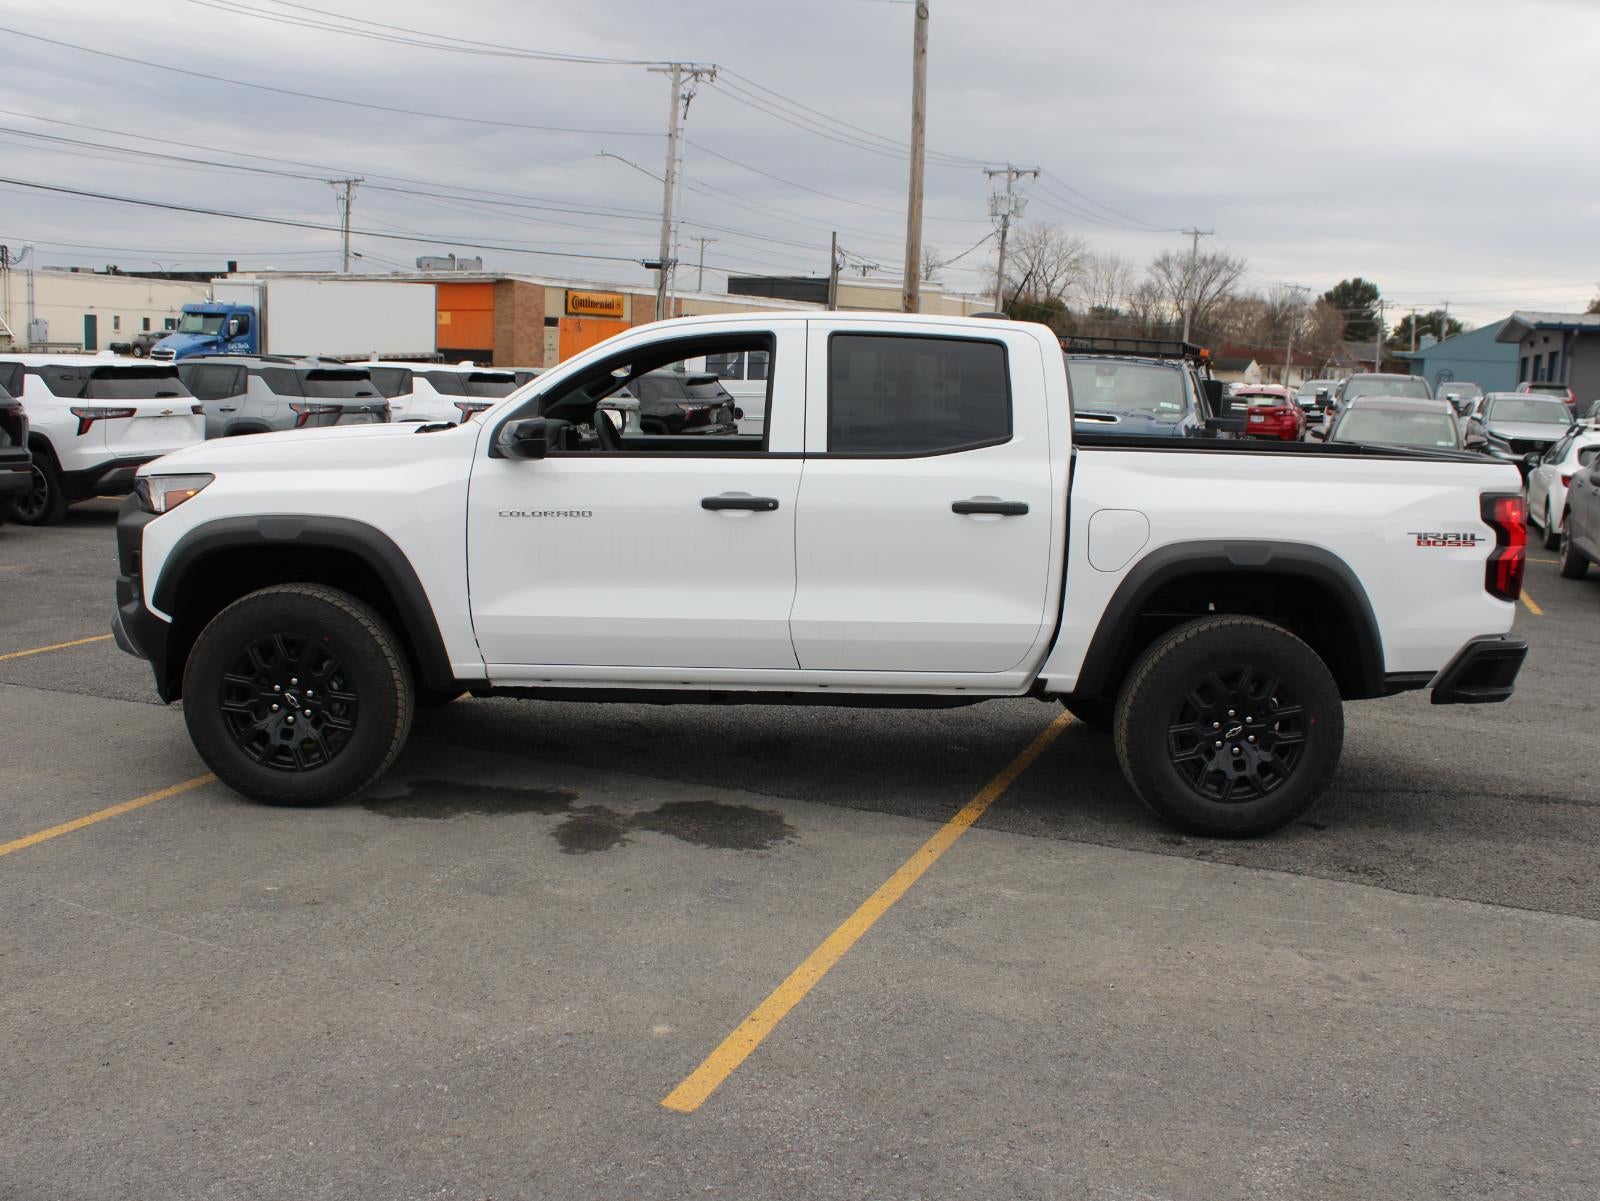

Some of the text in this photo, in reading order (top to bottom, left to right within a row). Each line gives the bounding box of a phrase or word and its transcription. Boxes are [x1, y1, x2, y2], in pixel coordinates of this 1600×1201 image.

[571, 295, 615, 310] Continental
[498, 510, 593, 518] COLORADO
[1407, 532, 1486, 541] TRAIL
